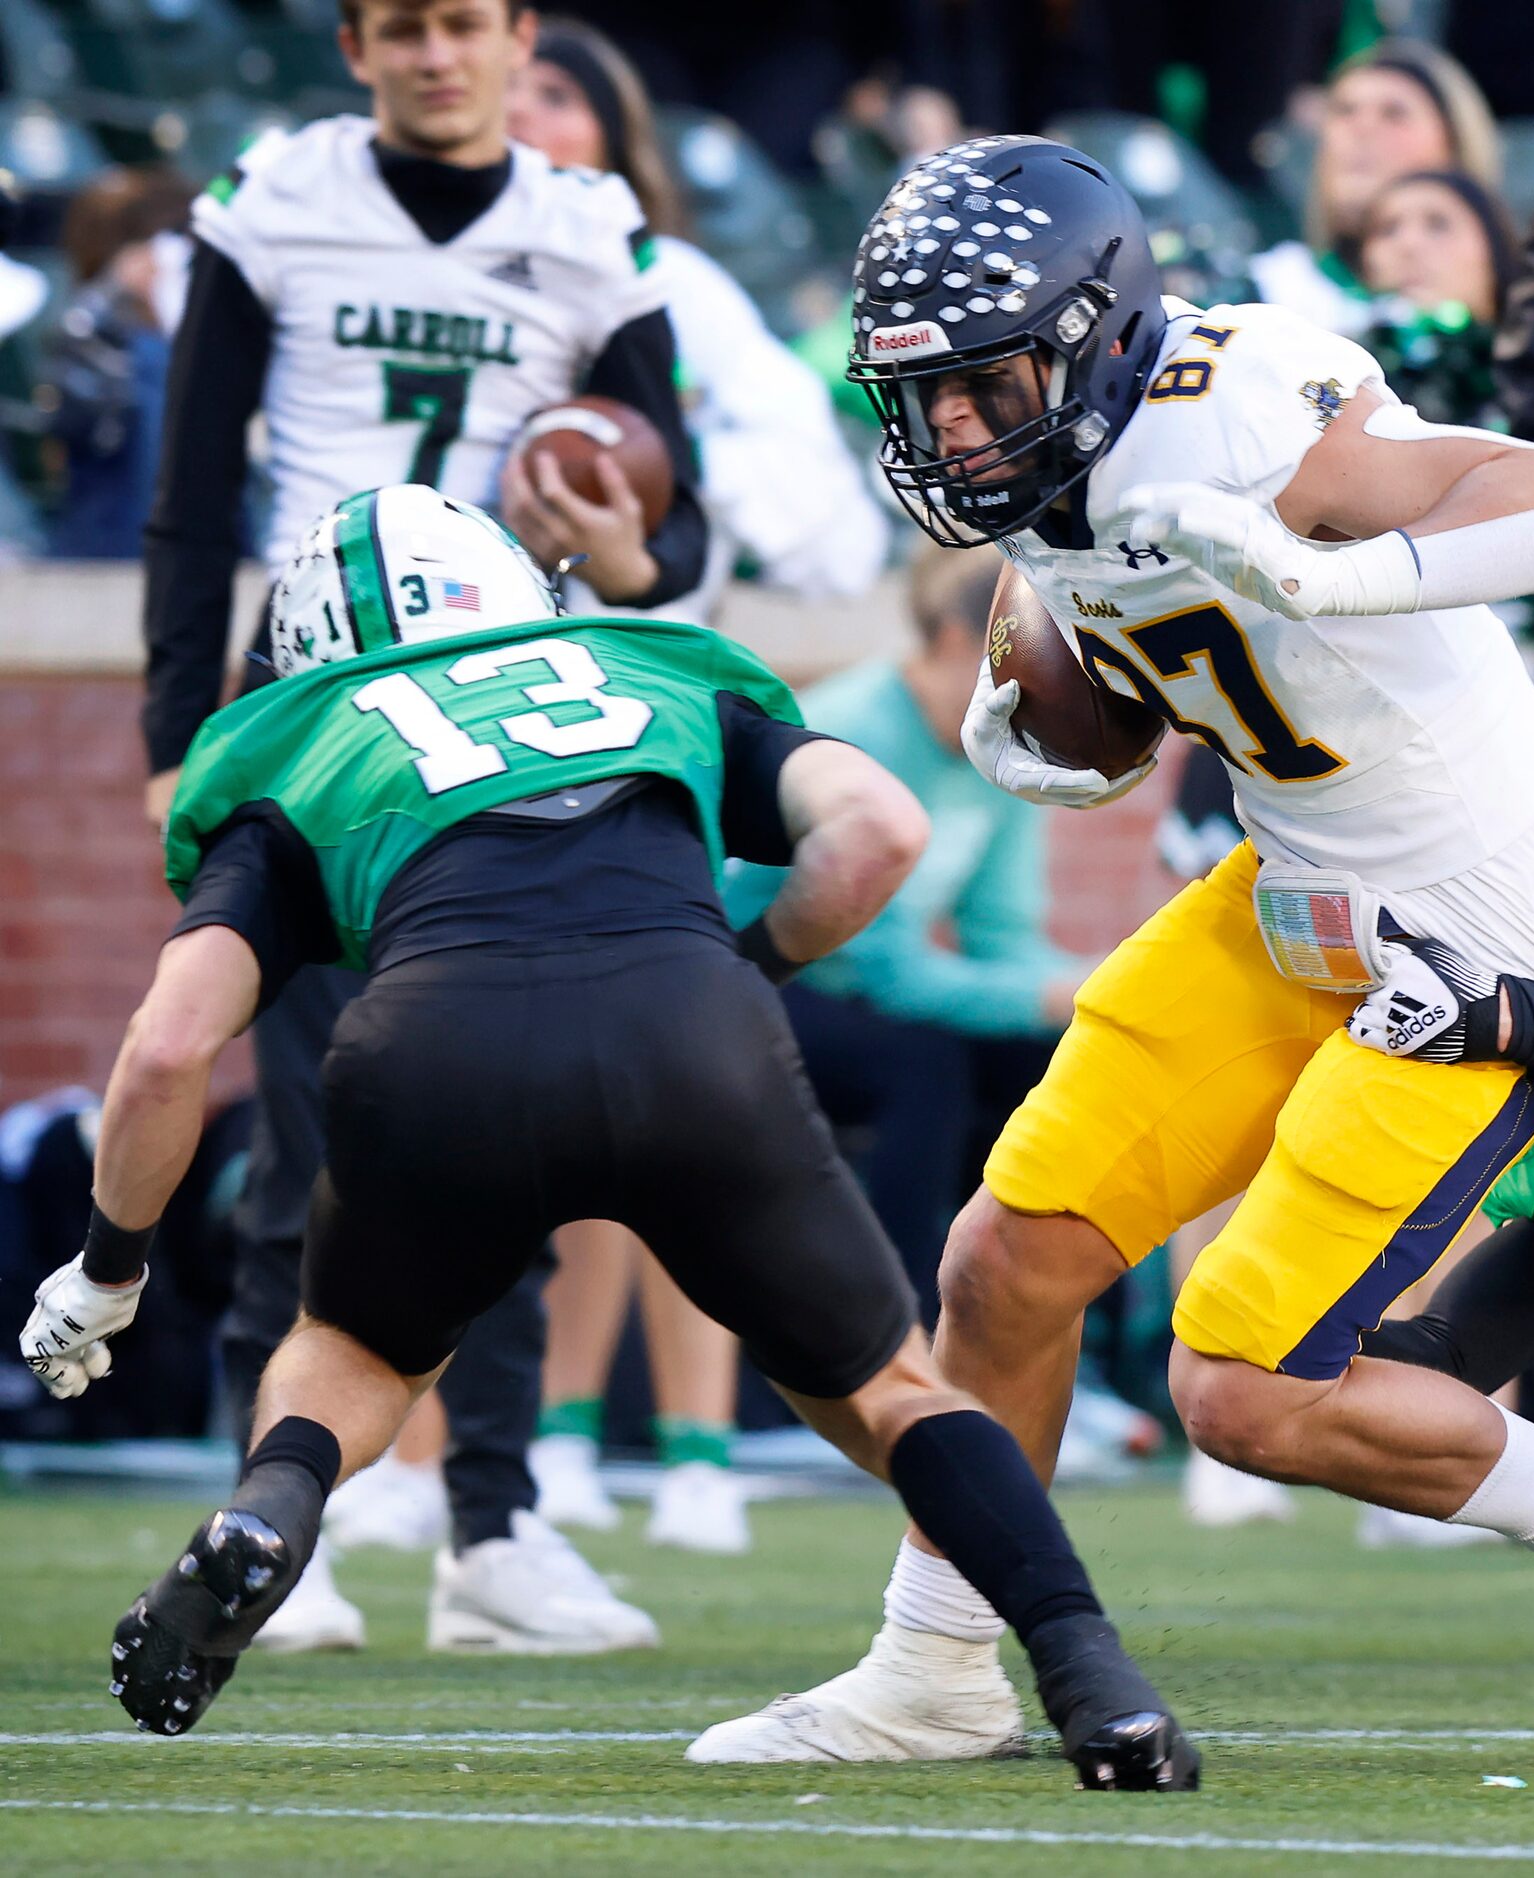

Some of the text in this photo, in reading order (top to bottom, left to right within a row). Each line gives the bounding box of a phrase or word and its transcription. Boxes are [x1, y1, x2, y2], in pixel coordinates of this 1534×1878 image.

[335, 304, 520, 366] CARROLL
[874, 330, 931, 350] Riddell
[380, 360, 477, 490] 7
[400, 574, 430, 616] 3
[352, 637, 653, 795] 13
[1387, 1005, 1446, 1050] adidas
